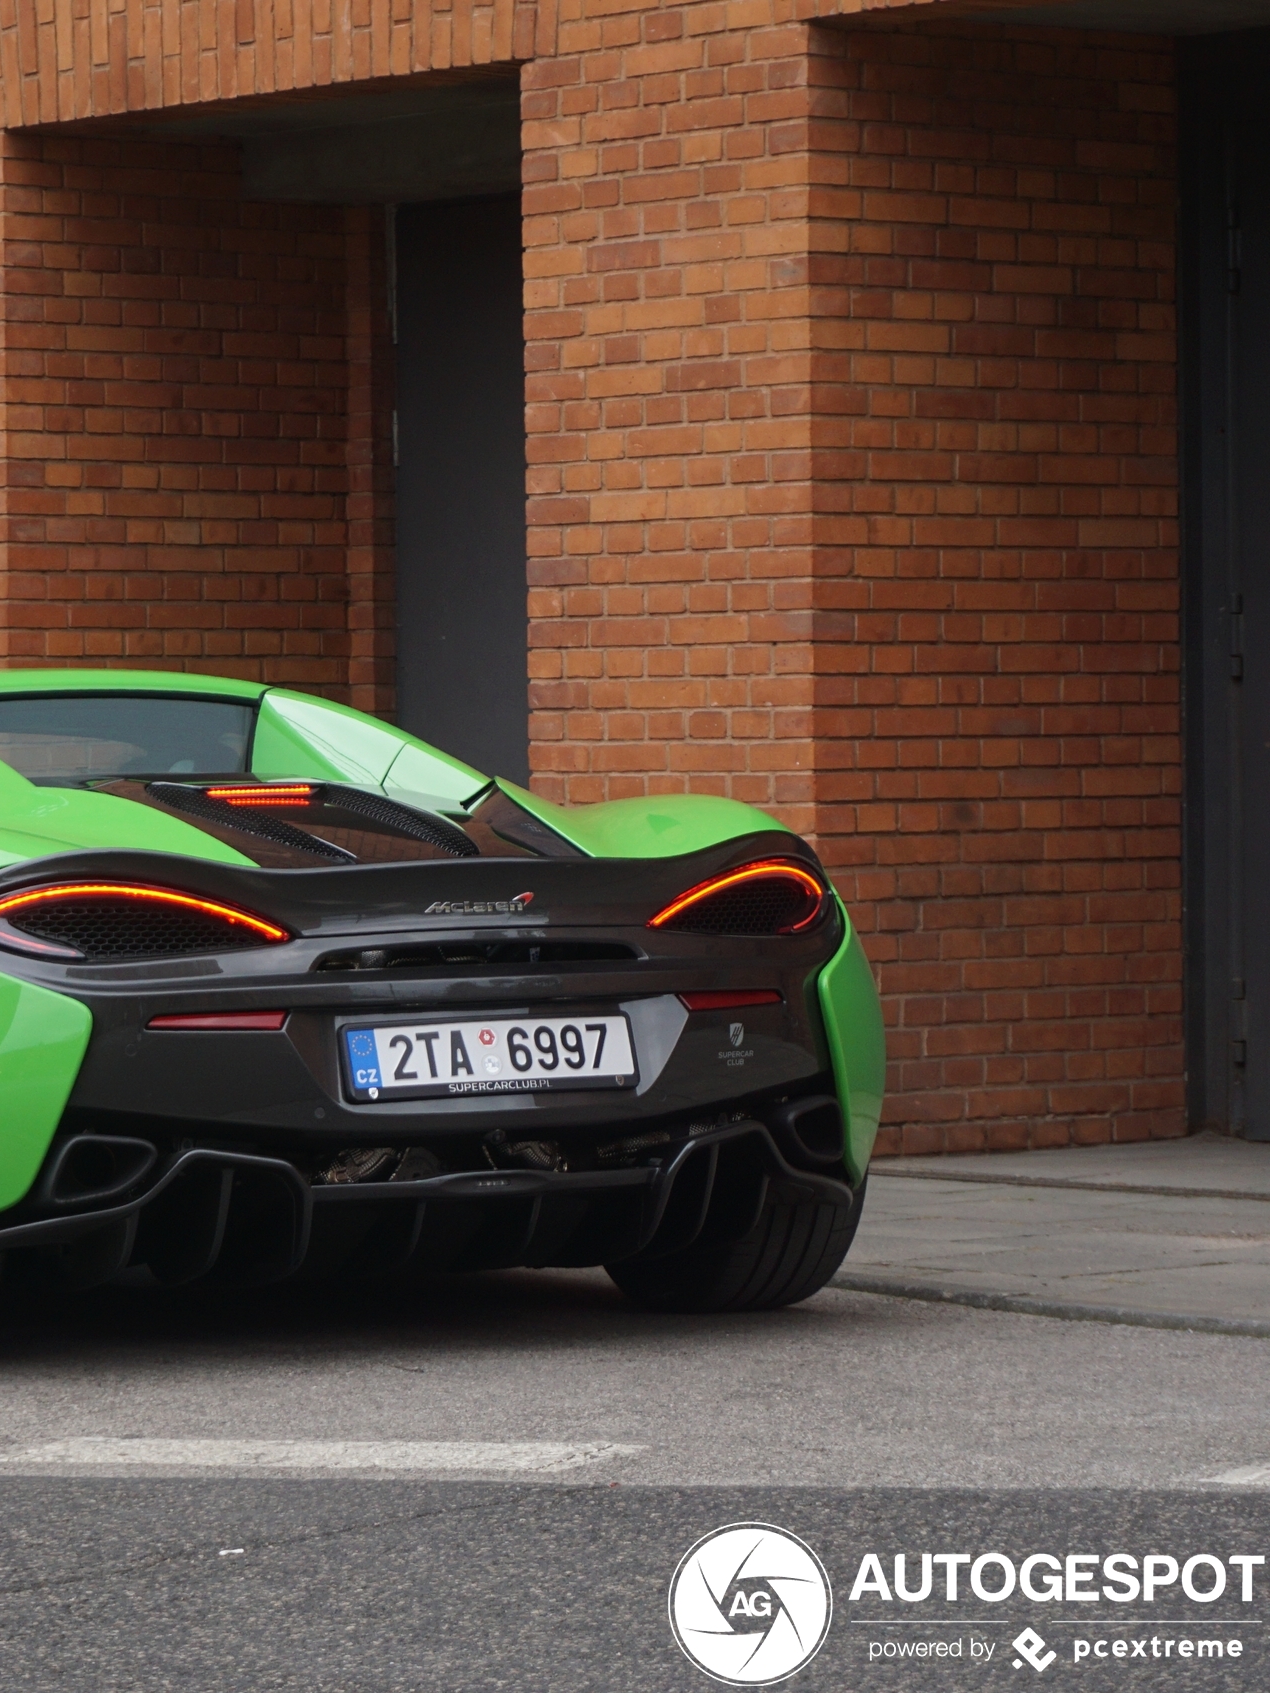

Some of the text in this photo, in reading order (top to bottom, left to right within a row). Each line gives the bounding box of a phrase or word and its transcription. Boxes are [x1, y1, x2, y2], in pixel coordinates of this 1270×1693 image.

[424, 900, 523, 914] McLaren
[389, 1022, 608, 1081] 2TA 6997
[718, 1049, 754, 1059] SUPERCAR
[726, 1059, 745, 1067] CLUB
[356, 1068, 378, 1084] CZ
[448, 1079, 553, 1093] SUPERCARCLUB.PL
